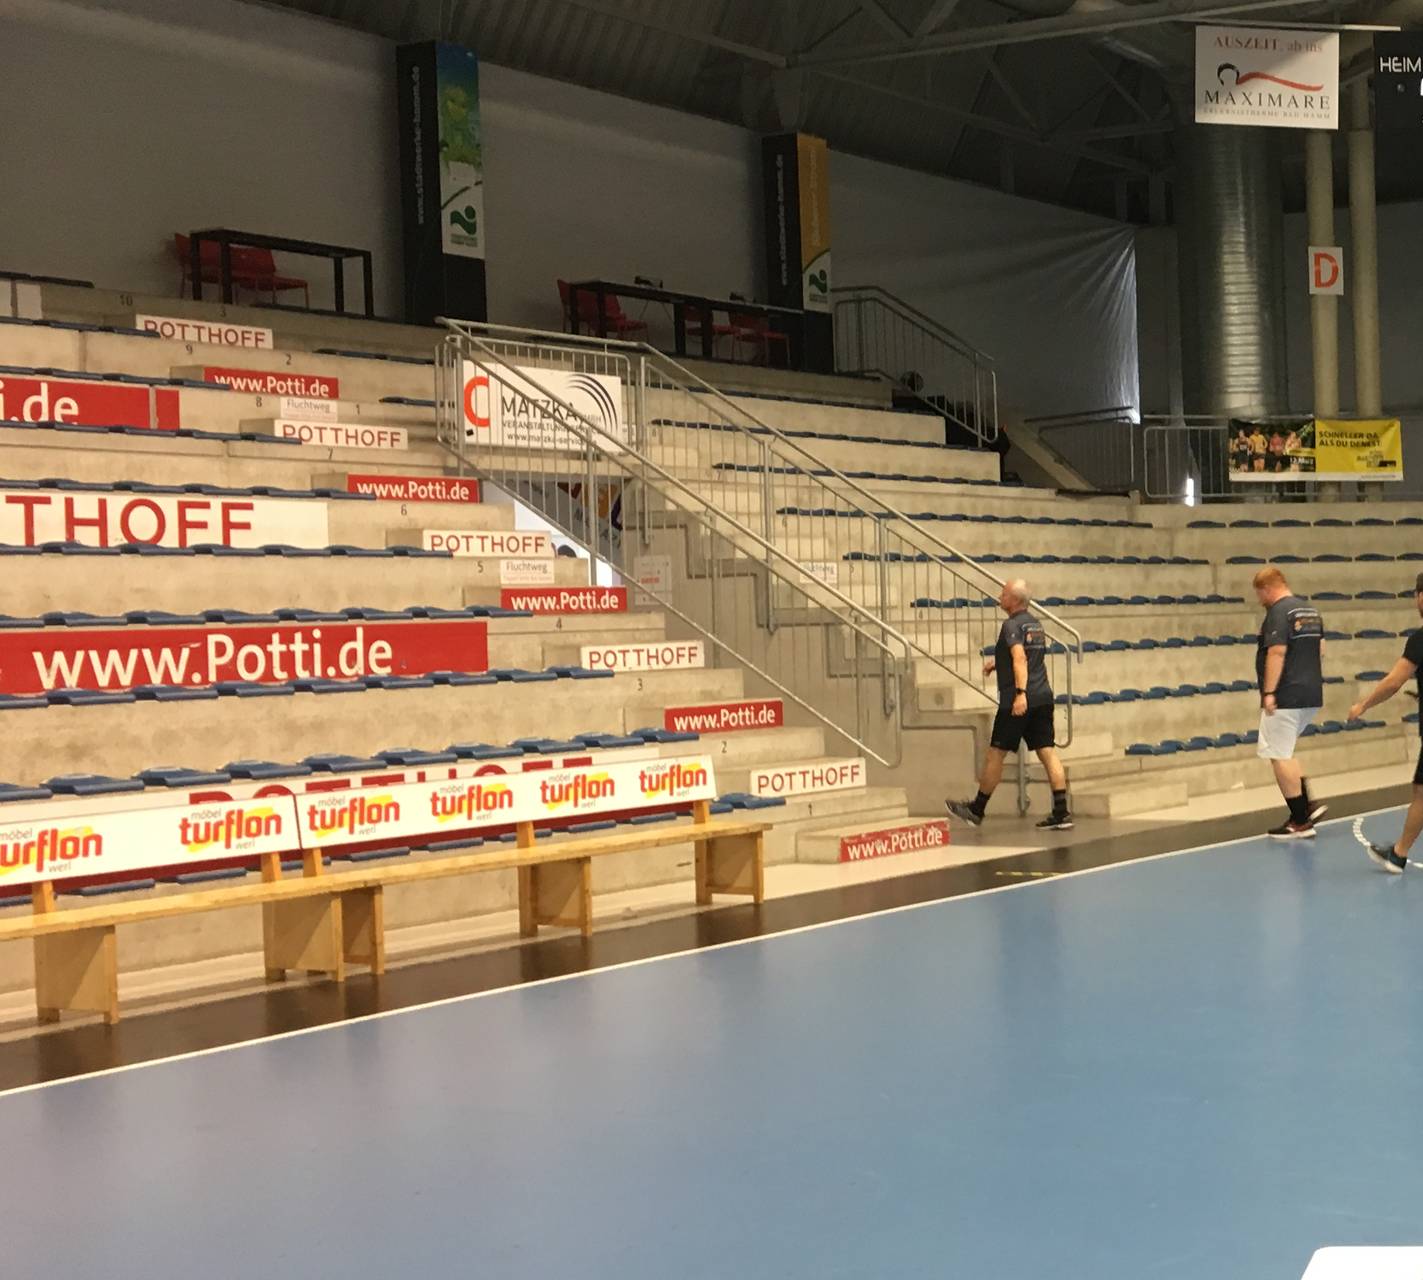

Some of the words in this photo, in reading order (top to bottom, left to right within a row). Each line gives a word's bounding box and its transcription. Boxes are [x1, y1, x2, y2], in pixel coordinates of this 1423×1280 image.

[1380, 56, 1422, 73] HEIM
[1204, 90, 1331, 110] MAXIMARE
[1314, 252, 1340, 288] D
[144, 320, 267, 348] POTTHOFF
[215, 375, 330, 398] www.Potti.de
[463, 376, 491, 428] C
[282, 424, 401, 449] POTTHOFF
[1336, 440, 1348, 448] DU
[356, 480, 471, 501] www.Potti.de
[430, 534, 546, 555] POTTHOFF
[477, 562, 484, 575] 5
[506, 561, 549, 575] Fluchtweg
[511, 591, 620, 612] www.Potti.de
[33, 627, 393, 690] www.Potti.de
[589, 646, 699, 673] POTTHOFF
[674, 704, 777, 731] www.Potti.de
[721, 741, 728, 754] 2
[540, 774, 615, 808] turflon
[639, 764, 707, 797] turflon
[757, 764, 861, 794] POTTHOFF
[191, 808, 222, 820] möbel
[318, 796, 346, 807] möbel
[430, 784, 513, 820] turflon
[307, 796, 400, 835] turflon
[179, 809, 282, 850] turflon
[847, 824, 944, 861] www.Potti.de
